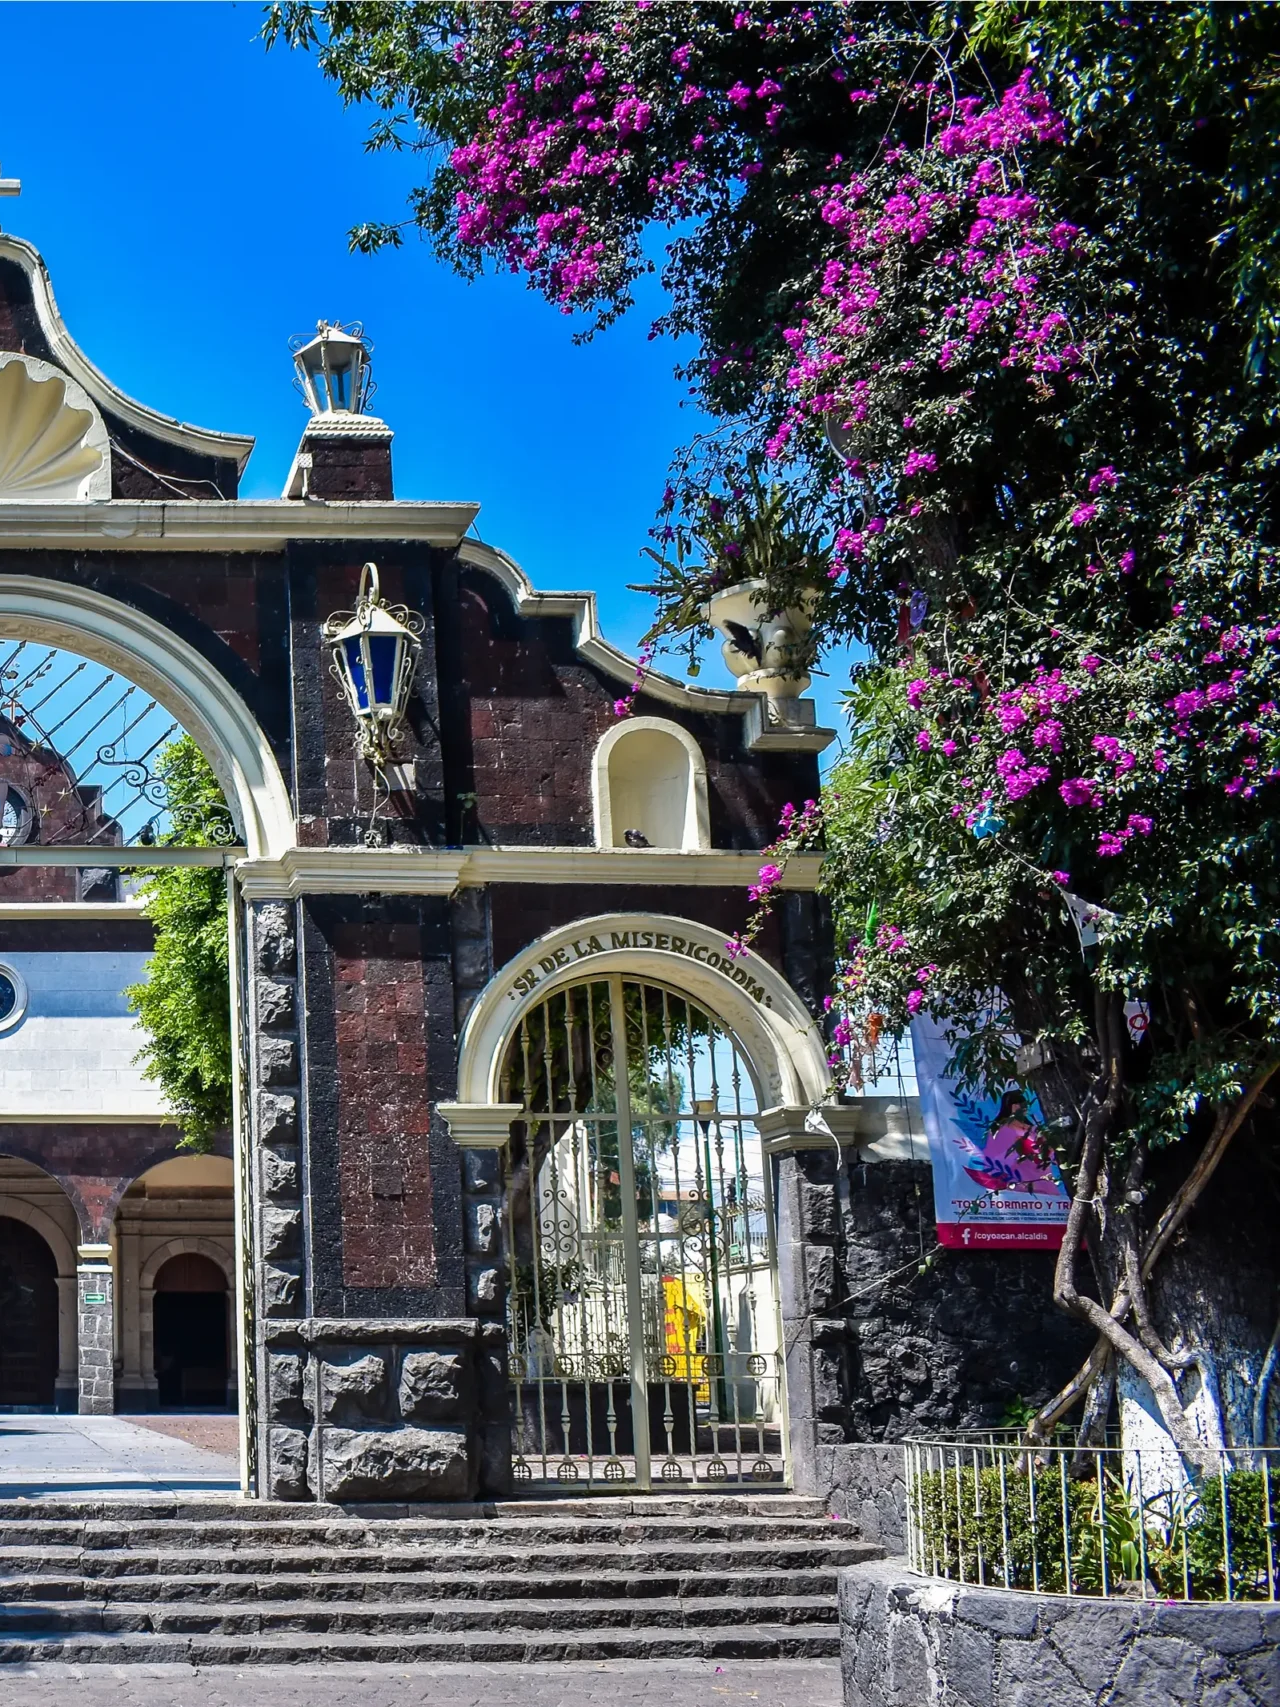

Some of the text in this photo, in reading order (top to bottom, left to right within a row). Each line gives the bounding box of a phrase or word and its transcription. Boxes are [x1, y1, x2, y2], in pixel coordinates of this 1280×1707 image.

[513, 931, 767, 1003] SR DE LA MISERICORDIA
[990, 1201, 1043, 1210] FORMATO
[1046, 1201, 1053, 1210] Y
